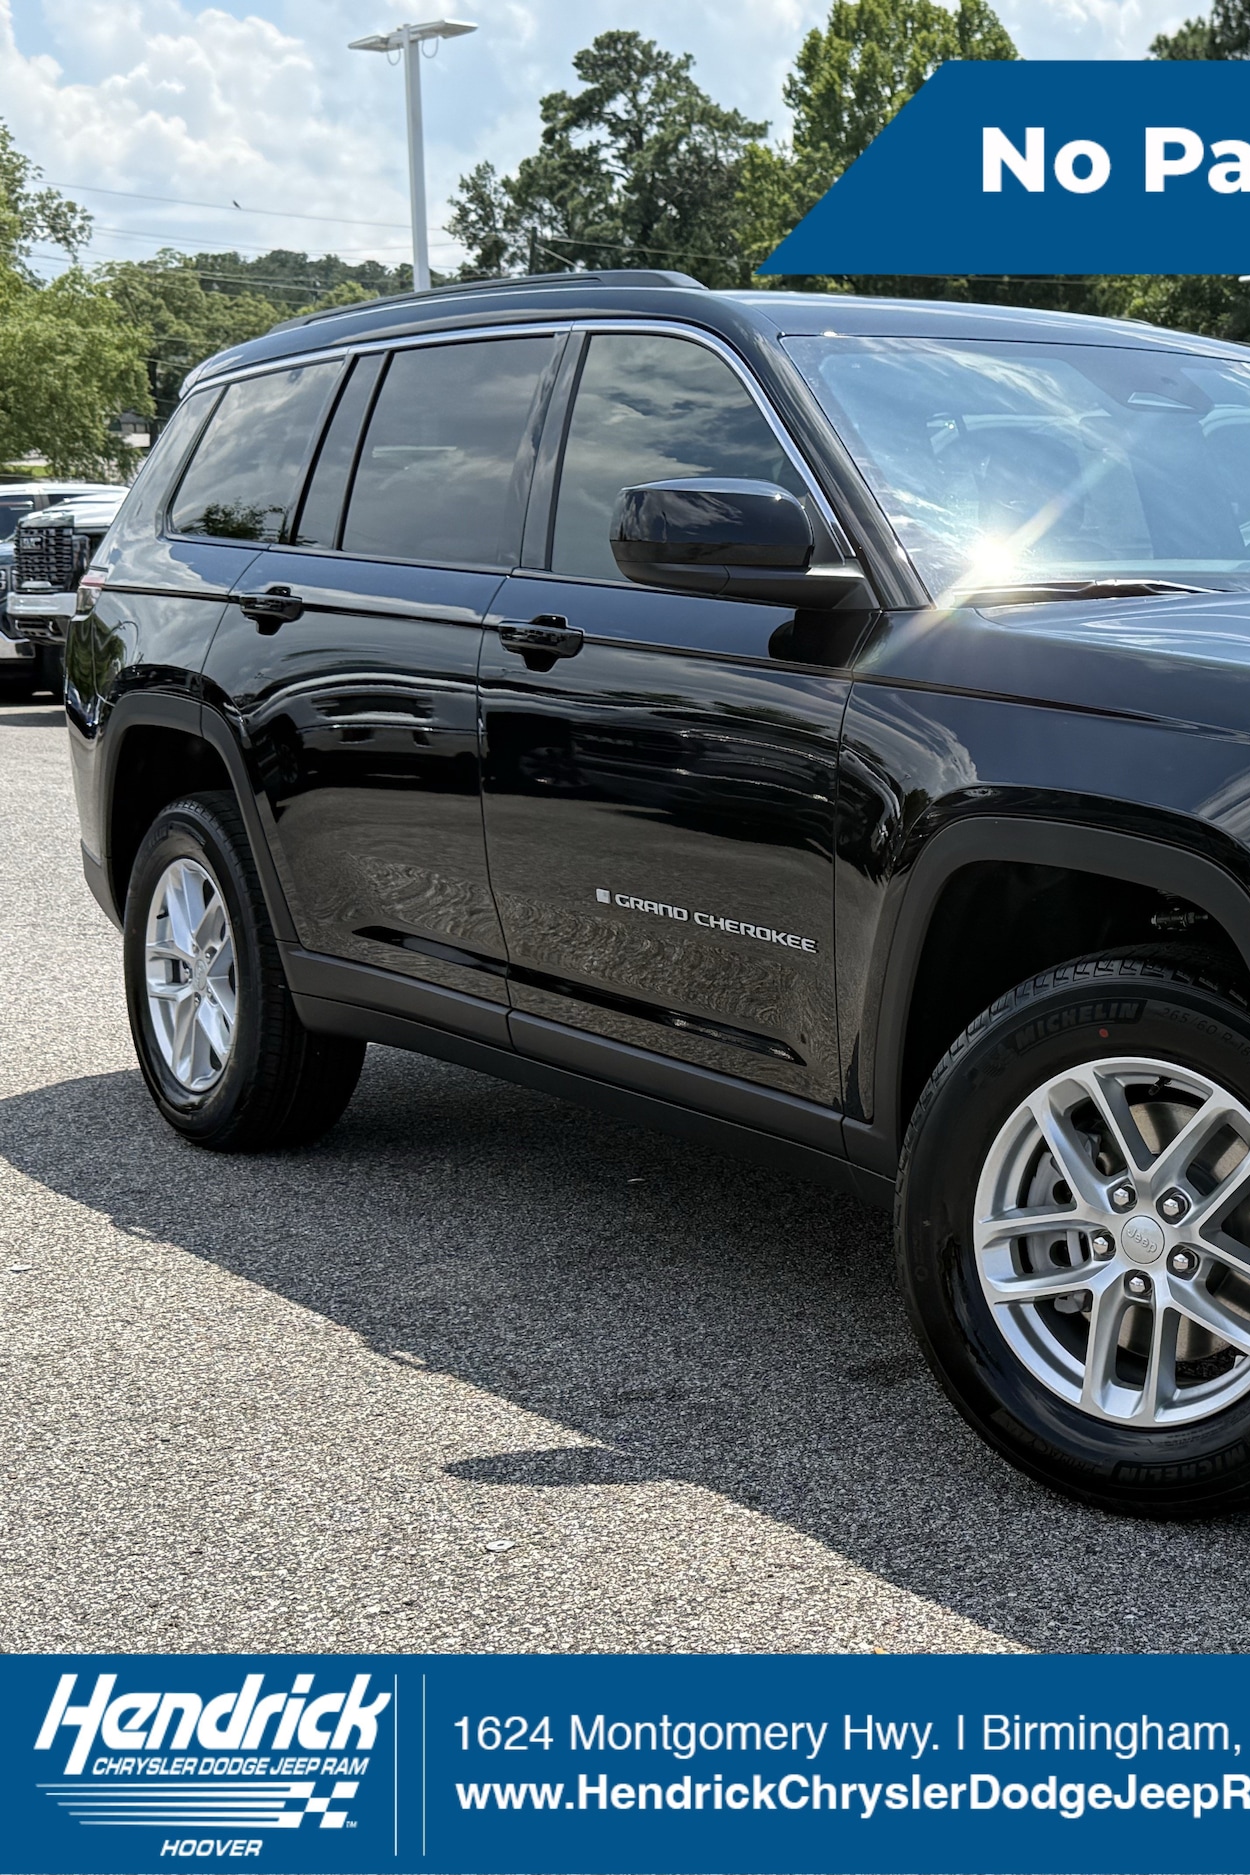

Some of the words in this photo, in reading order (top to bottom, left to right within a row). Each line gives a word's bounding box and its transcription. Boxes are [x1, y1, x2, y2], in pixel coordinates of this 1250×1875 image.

[614, 893, 689, 922] GRAND
[693, 911, 818, 954] CHEROKEE
[1015, 1001, 1139, 1050] MICHELIN
[1125, 1228, 1158, 1254] Jeep
[1118, 1444, 1247, 1484] MICHELIN
